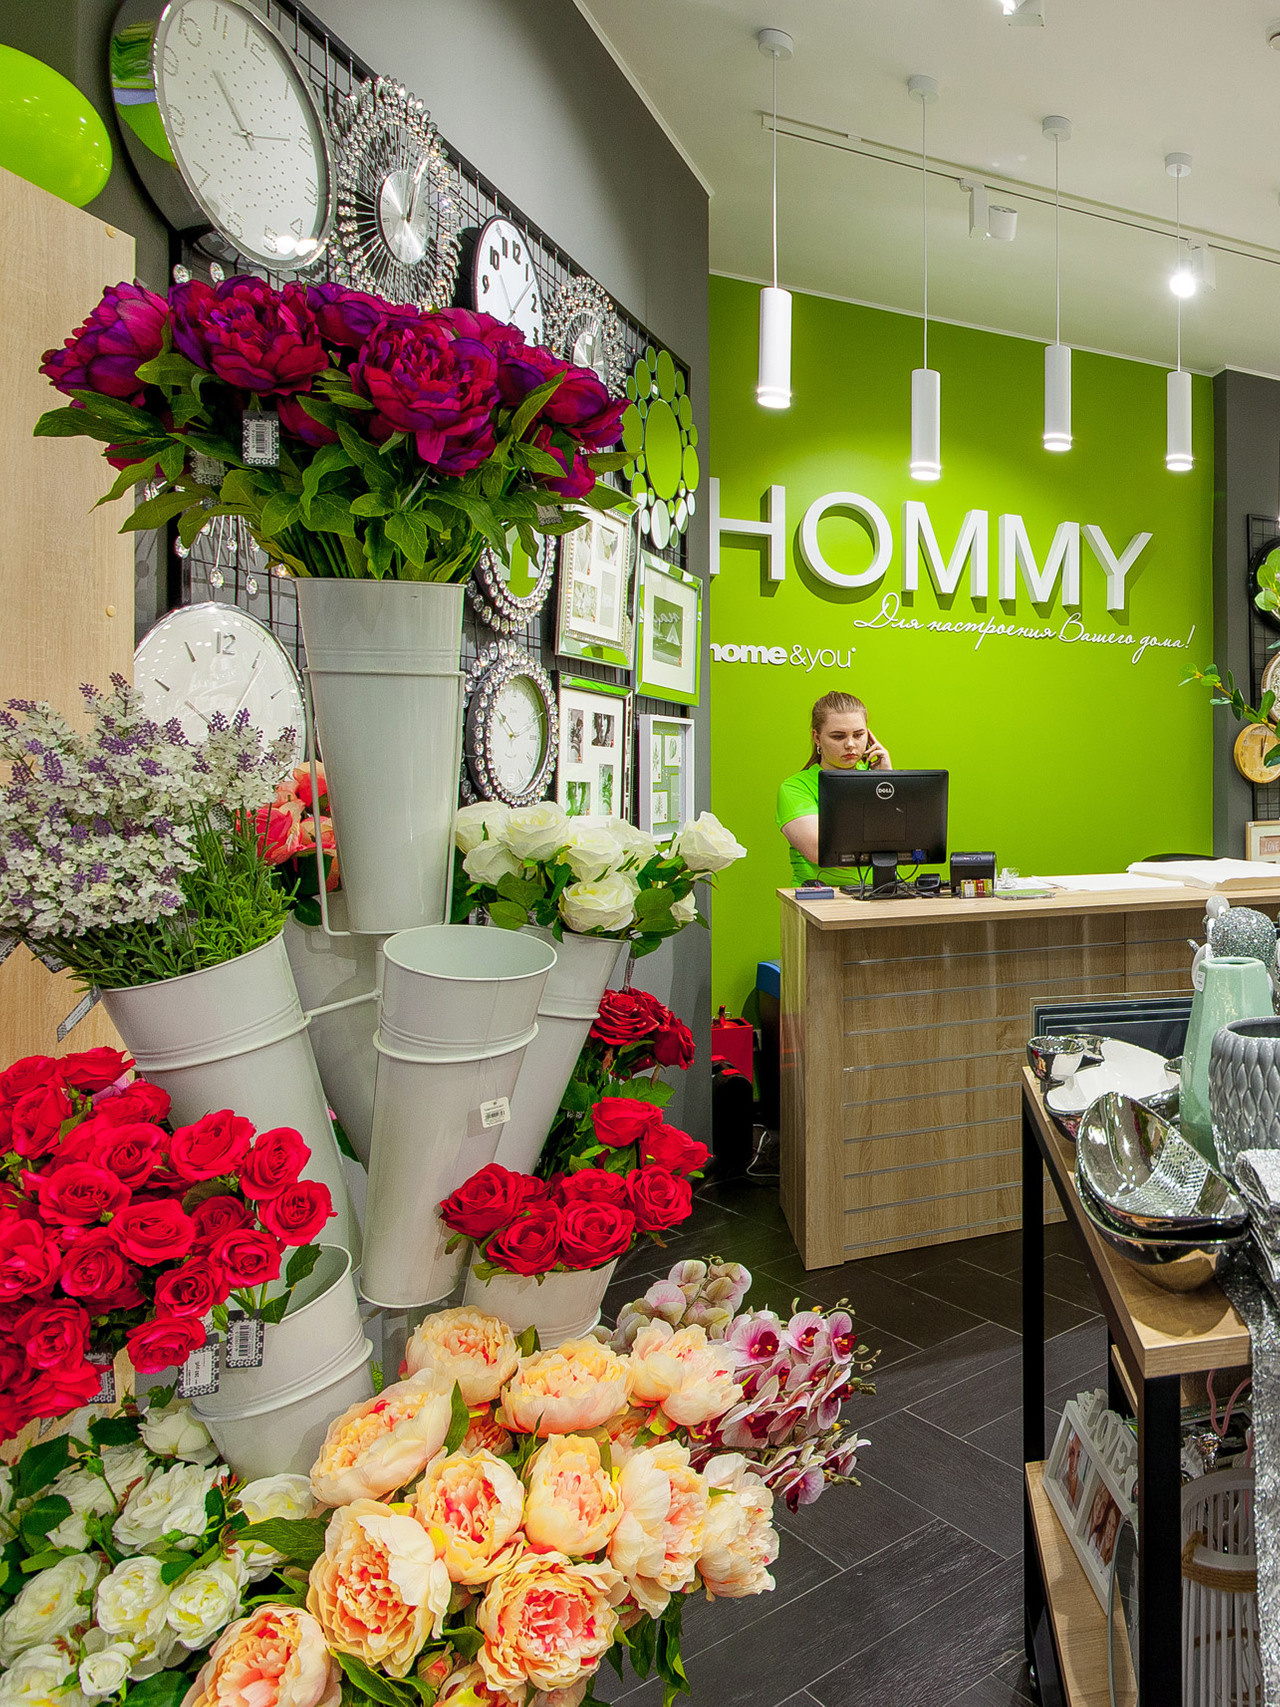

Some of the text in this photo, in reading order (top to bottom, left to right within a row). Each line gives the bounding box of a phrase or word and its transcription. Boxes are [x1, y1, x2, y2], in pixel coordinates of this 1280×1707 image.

[489, 245, 500, 271] 10
[482, 274, 490, 294] 9
[531, 293, 537, 314] 2
[708, 477, 1153, 612] HOMMY
[853, 592, 1196, 665] Для настроения Вашего дома!
[215, 631, 237, 656] 12
